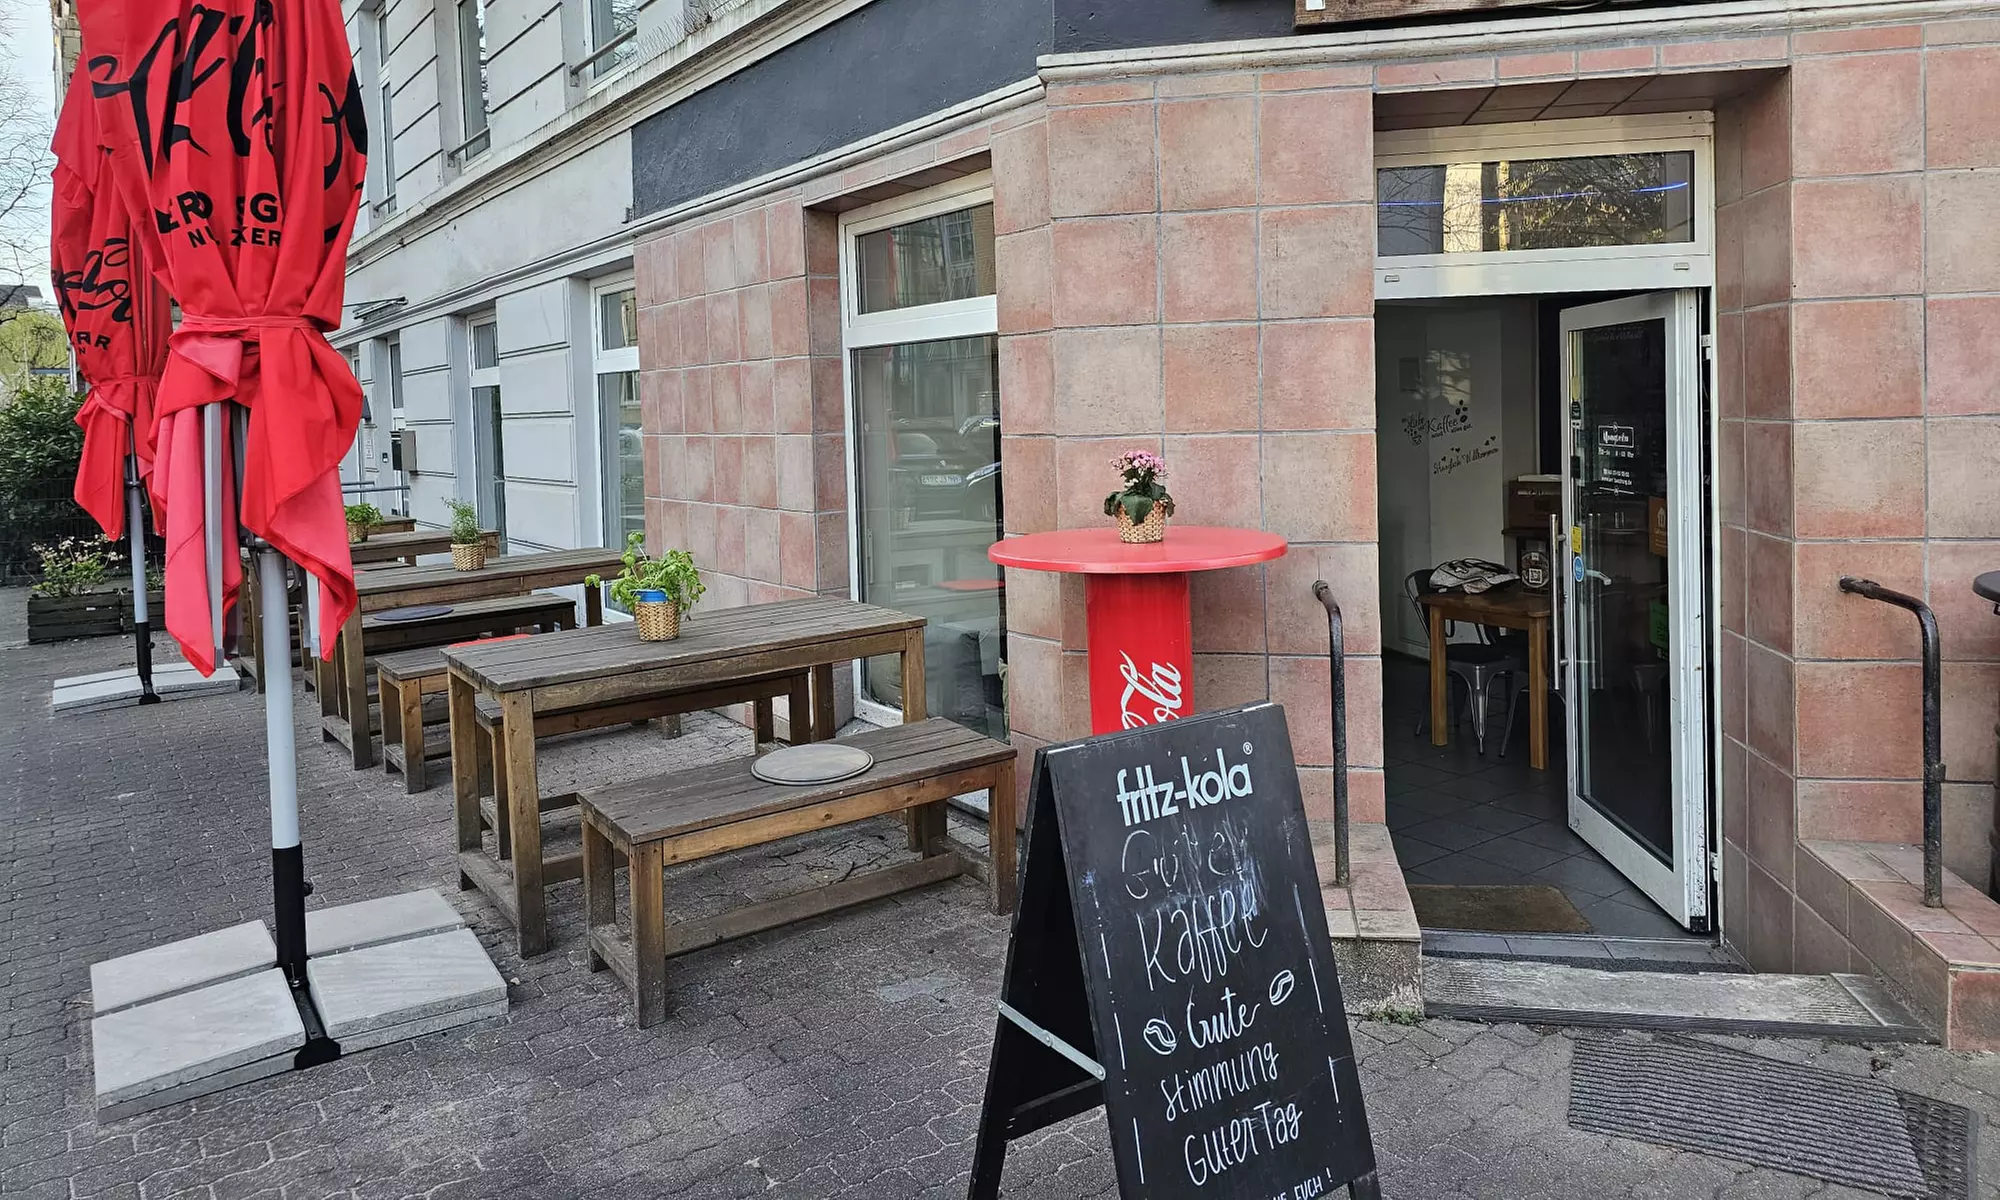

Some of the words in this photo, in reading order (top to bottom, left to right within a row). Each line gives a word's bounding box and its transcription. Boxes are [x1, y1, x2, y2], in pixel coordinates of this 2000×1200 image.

[1426, 414, 1459, 434] Kaffee
[1135, 882, 1269, 991] Kaffee
[1187, 986, 1261, 1049] Gute
